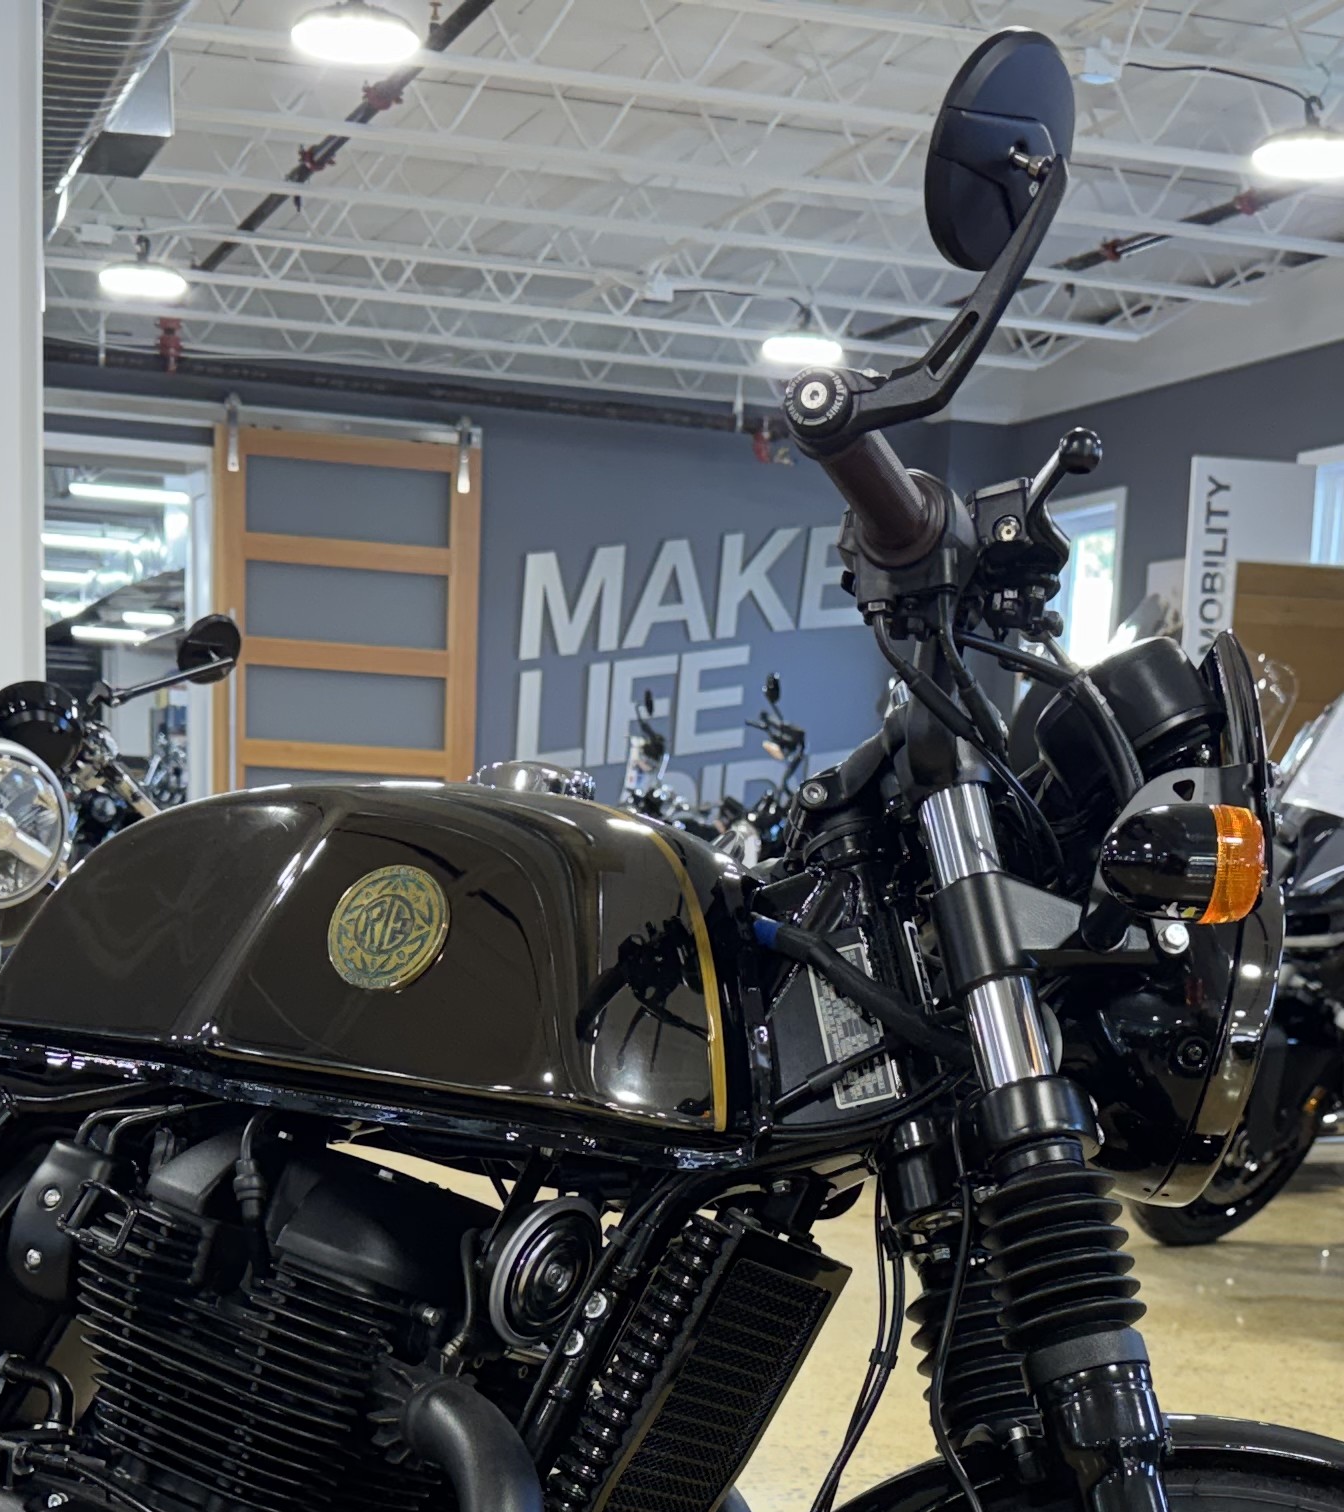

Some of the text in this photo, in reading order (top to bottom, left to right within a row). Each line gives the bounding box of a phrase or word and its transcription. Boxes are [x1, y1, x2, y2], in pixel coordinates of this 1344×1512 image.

[518, 524, 872, 660] MAKE
[1198, 475, 1232, 657] MOBILITY
[516, 644, 751, 770] LIFE
